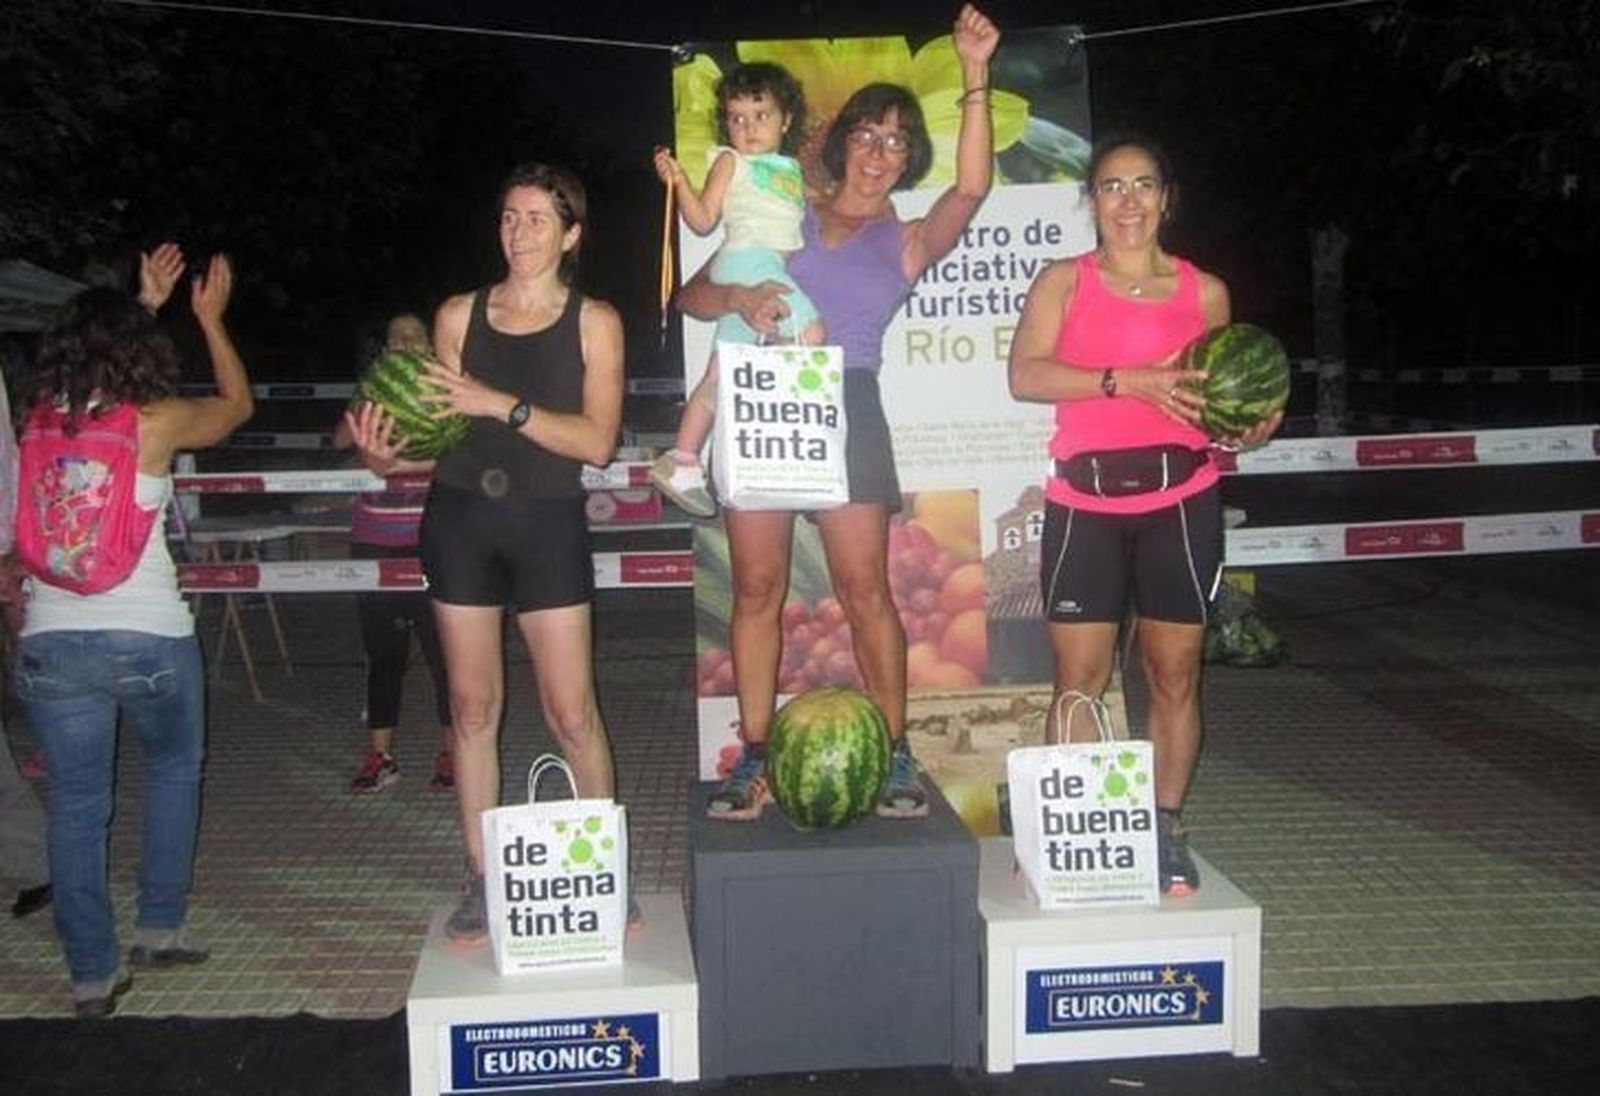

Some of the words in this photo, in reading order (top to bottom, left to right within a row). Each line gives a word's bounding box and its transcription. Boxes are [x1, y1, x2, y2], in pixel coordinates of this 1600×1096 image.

[961, 225, 1011, 248] tro
[1024, 219, 1062, 245] de
[906, 326, 976, 365] Río
[994, 326, 1013, 363] E
[733, 361, 776, 391] de
[734, 393, 838, 428] buena
[735, 429, 828, 461] tinta
[1040, 768, 1085, 800] de
[1042, 805, 1150, 836] buena
[503, 836, 547, 867] de
[1045, 839, 1135, 871] tinta
[504, 872, 615, 902] buena
[507, 905, 599, 937] tinta
[1056, 991, 1186, 1019] EURONICS
[483, 1045, 622, 1075] EURONICS
